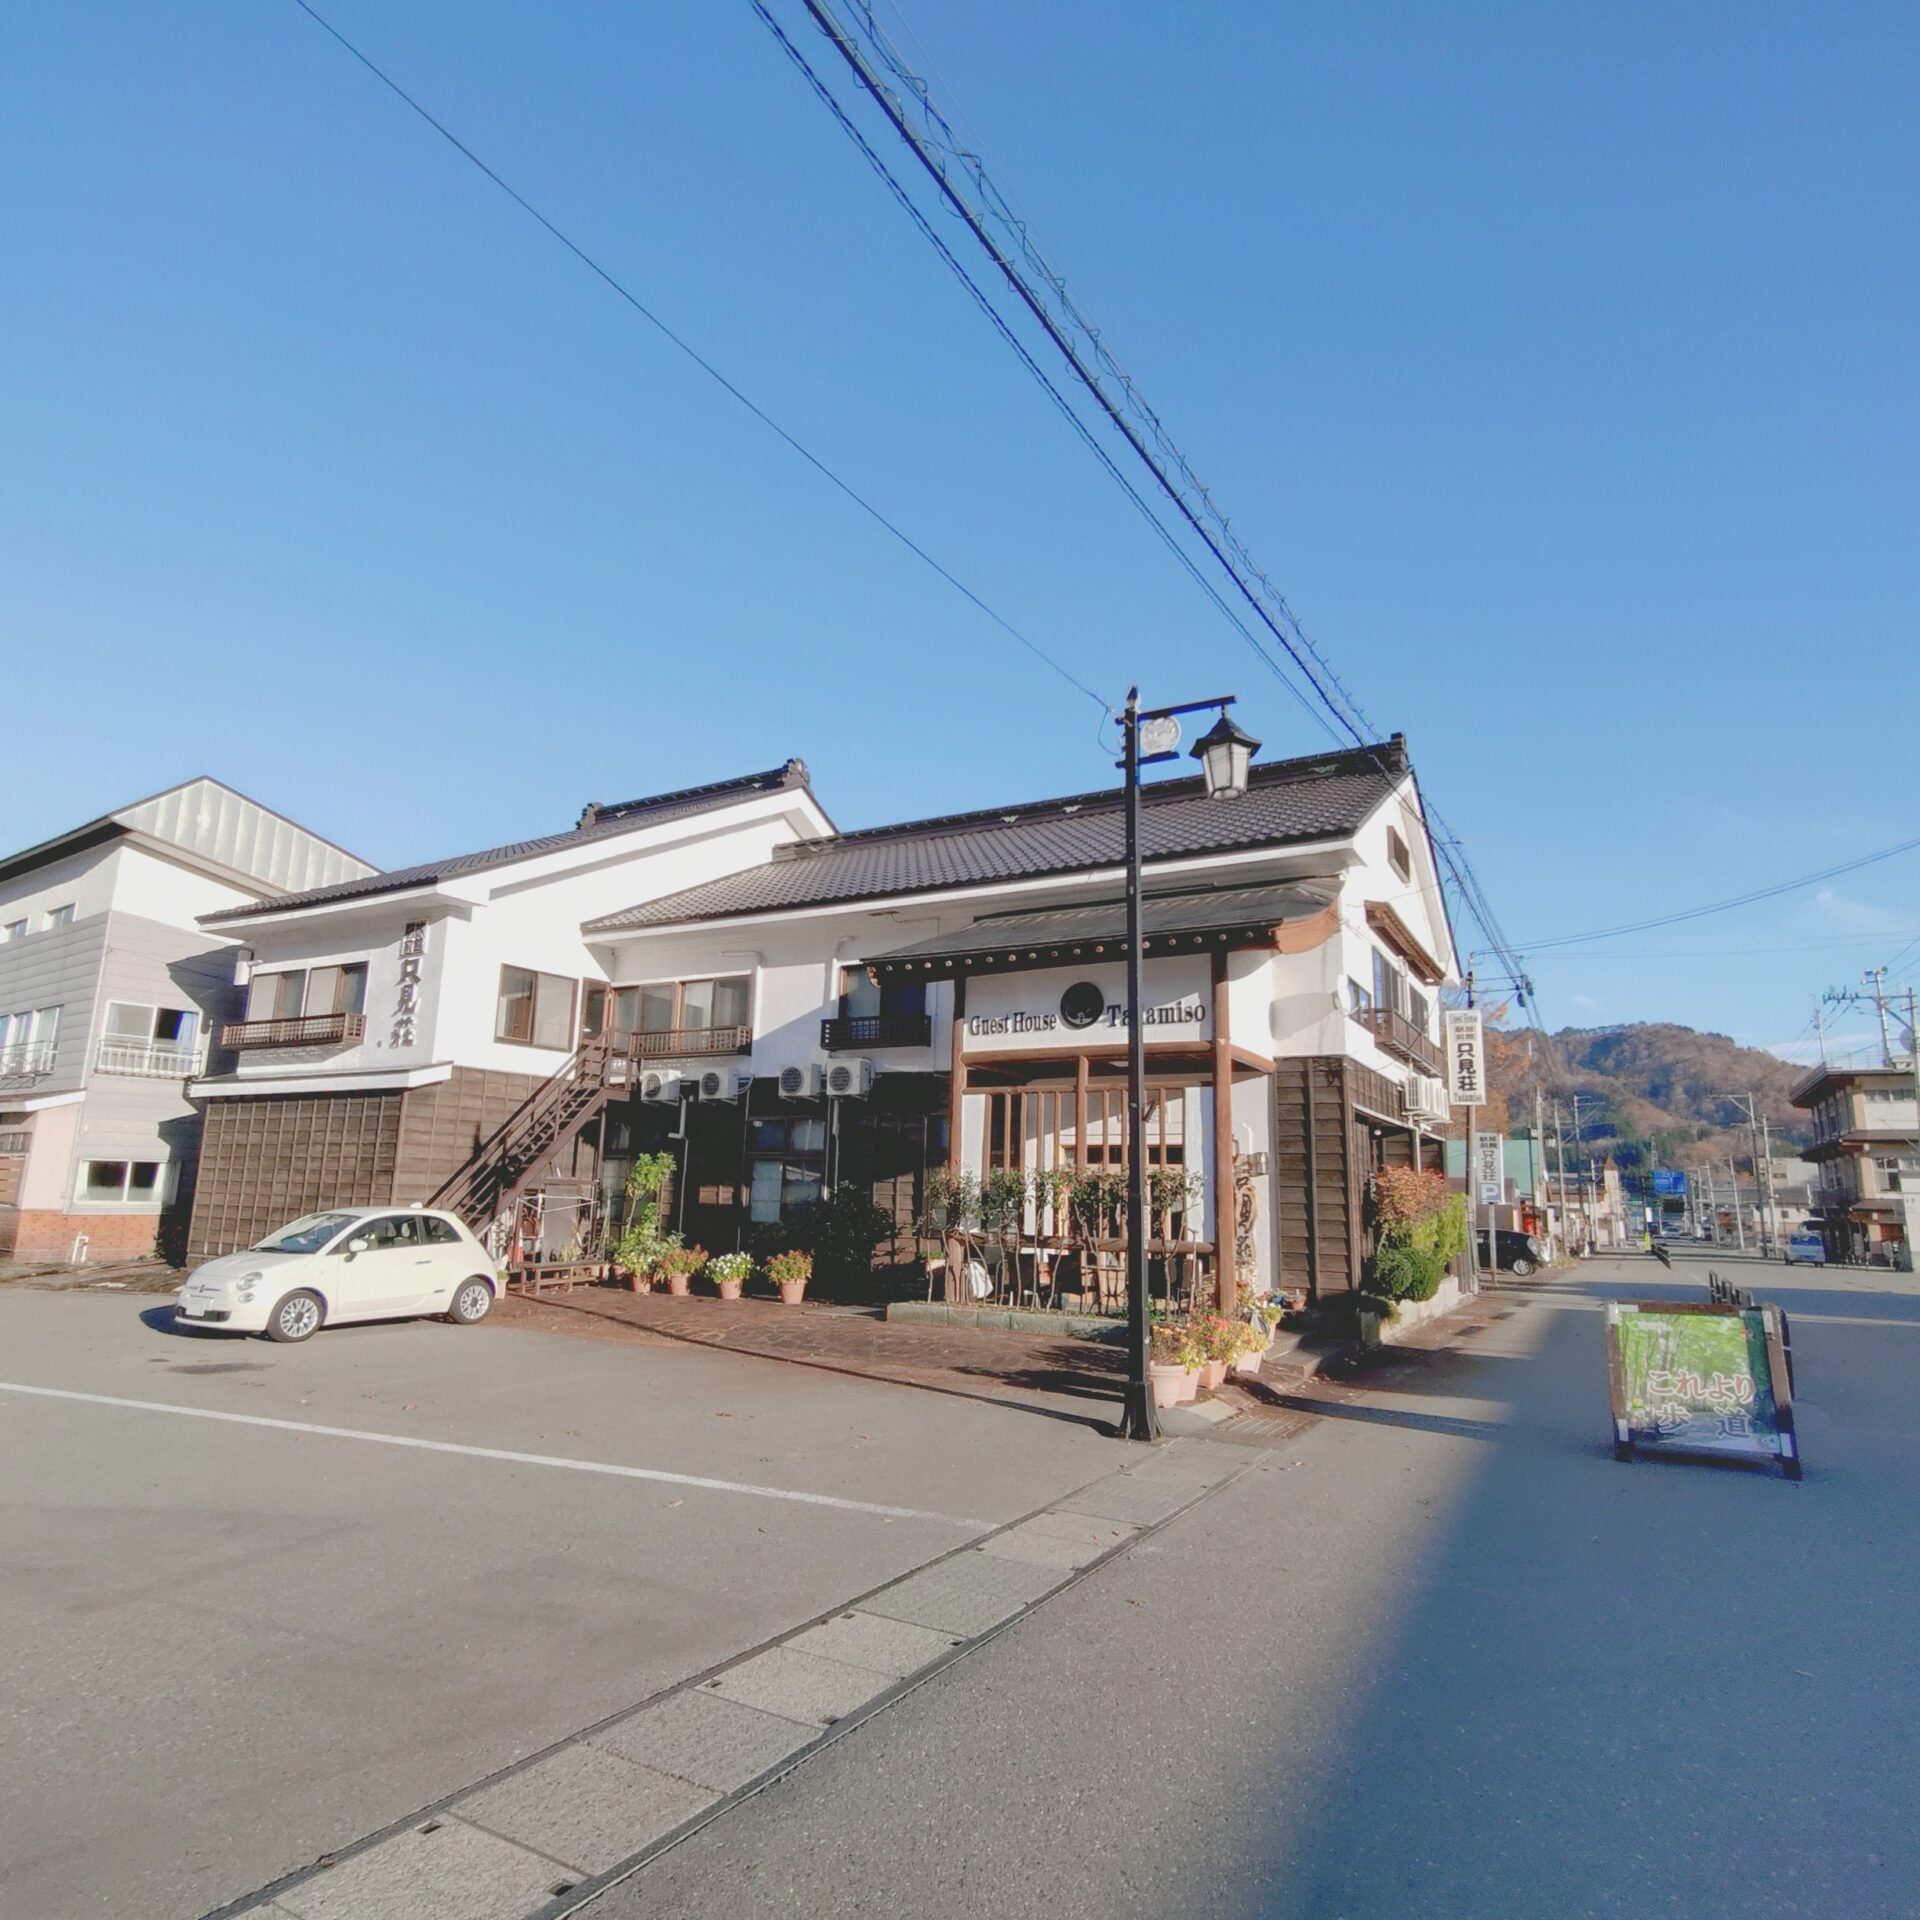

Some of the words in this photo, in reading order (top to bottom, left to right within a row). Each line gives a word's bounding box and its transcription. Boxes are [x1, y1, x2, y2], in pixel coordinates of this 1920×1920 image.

[1012, 1011, 1057, 1033] House
[1106, 1000, 1206, 1027] Taamiso
[1457, 1042, 1476, 1091] 只見荘
[1482, 1150, 1496, 1181] 只見荘
[1480, 1184, 1499, 1200] P
[1648, 1369, 1755, 1404] これより
